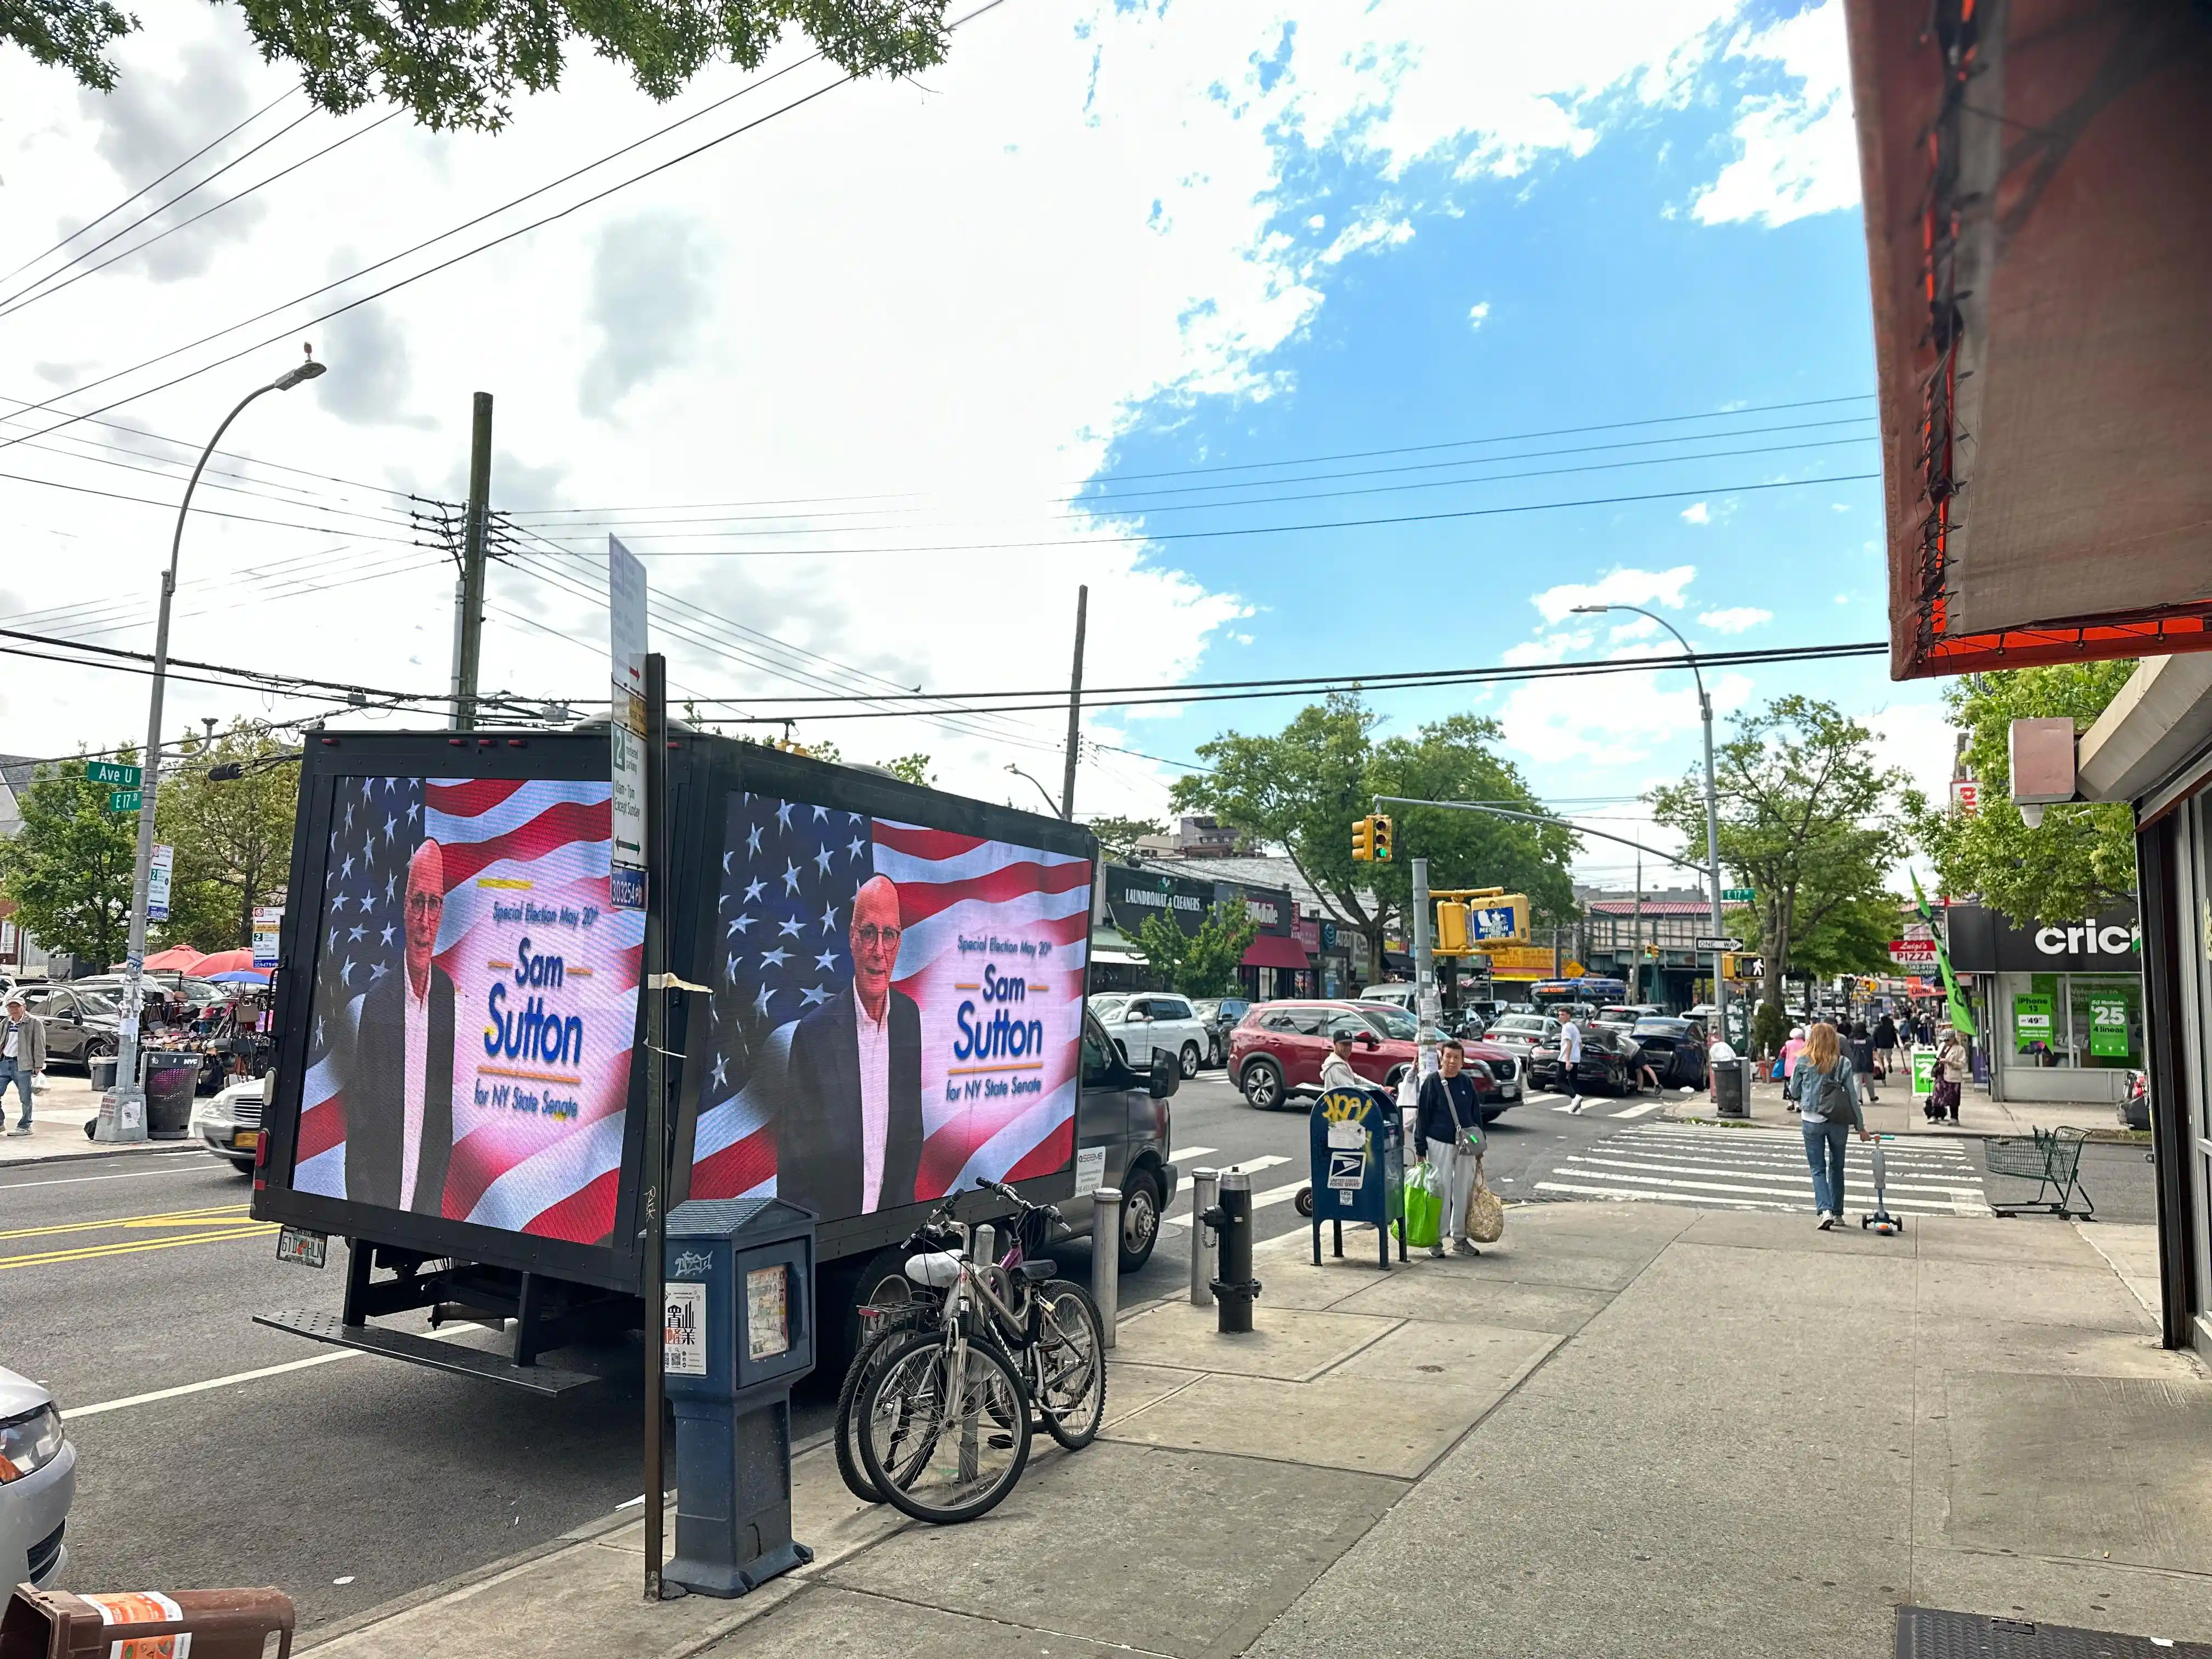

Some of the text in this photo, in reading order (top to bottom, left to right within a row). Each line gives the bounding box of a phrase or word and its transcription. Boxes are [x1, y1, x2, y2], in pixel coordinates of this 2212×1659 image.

[616, 729, 623, 766] 2
[99, 765, 133, 783] Ave U
[116, 794, 122, 809] E
[122, 793, 132, 808] 17
[614, 797, 641, 821] Except Sunday
[151, 870, 156, 881] 2
[612, 879, 635, 905] 303254
[1125, 888, 1167, 908] LAUNDROMAT
[1173, 894, 1201, 912] CLEANERS
[1727, 890, 1732, 900] E
[1734, 890, 1742, 900] 17
[493, 900, 523, 926] Special
[525, 901, 557, 922] Election
[558, 905, 579, 930] May
[958, 935, 987, 956] Special
[990, 937, 1018, 953] Election
[1020, 940, 1036, 957] May
[1896, 952, 1933, 961] PIZZA
[1899, 941, 1927, 951] Luigi's
[515, 936, 563, 988] Sam
[982, 963, 1025, 1002] Sam
[2017, 996, 2049, 1005] iPhone
[484, 982, 582, 1065] Sutton
[953, 1000, 1043, 1060] Sutton
[473, 1077, 578, 1118] for NY State Senate
[946, 1076, 1042, 1101] for NY State Senate
